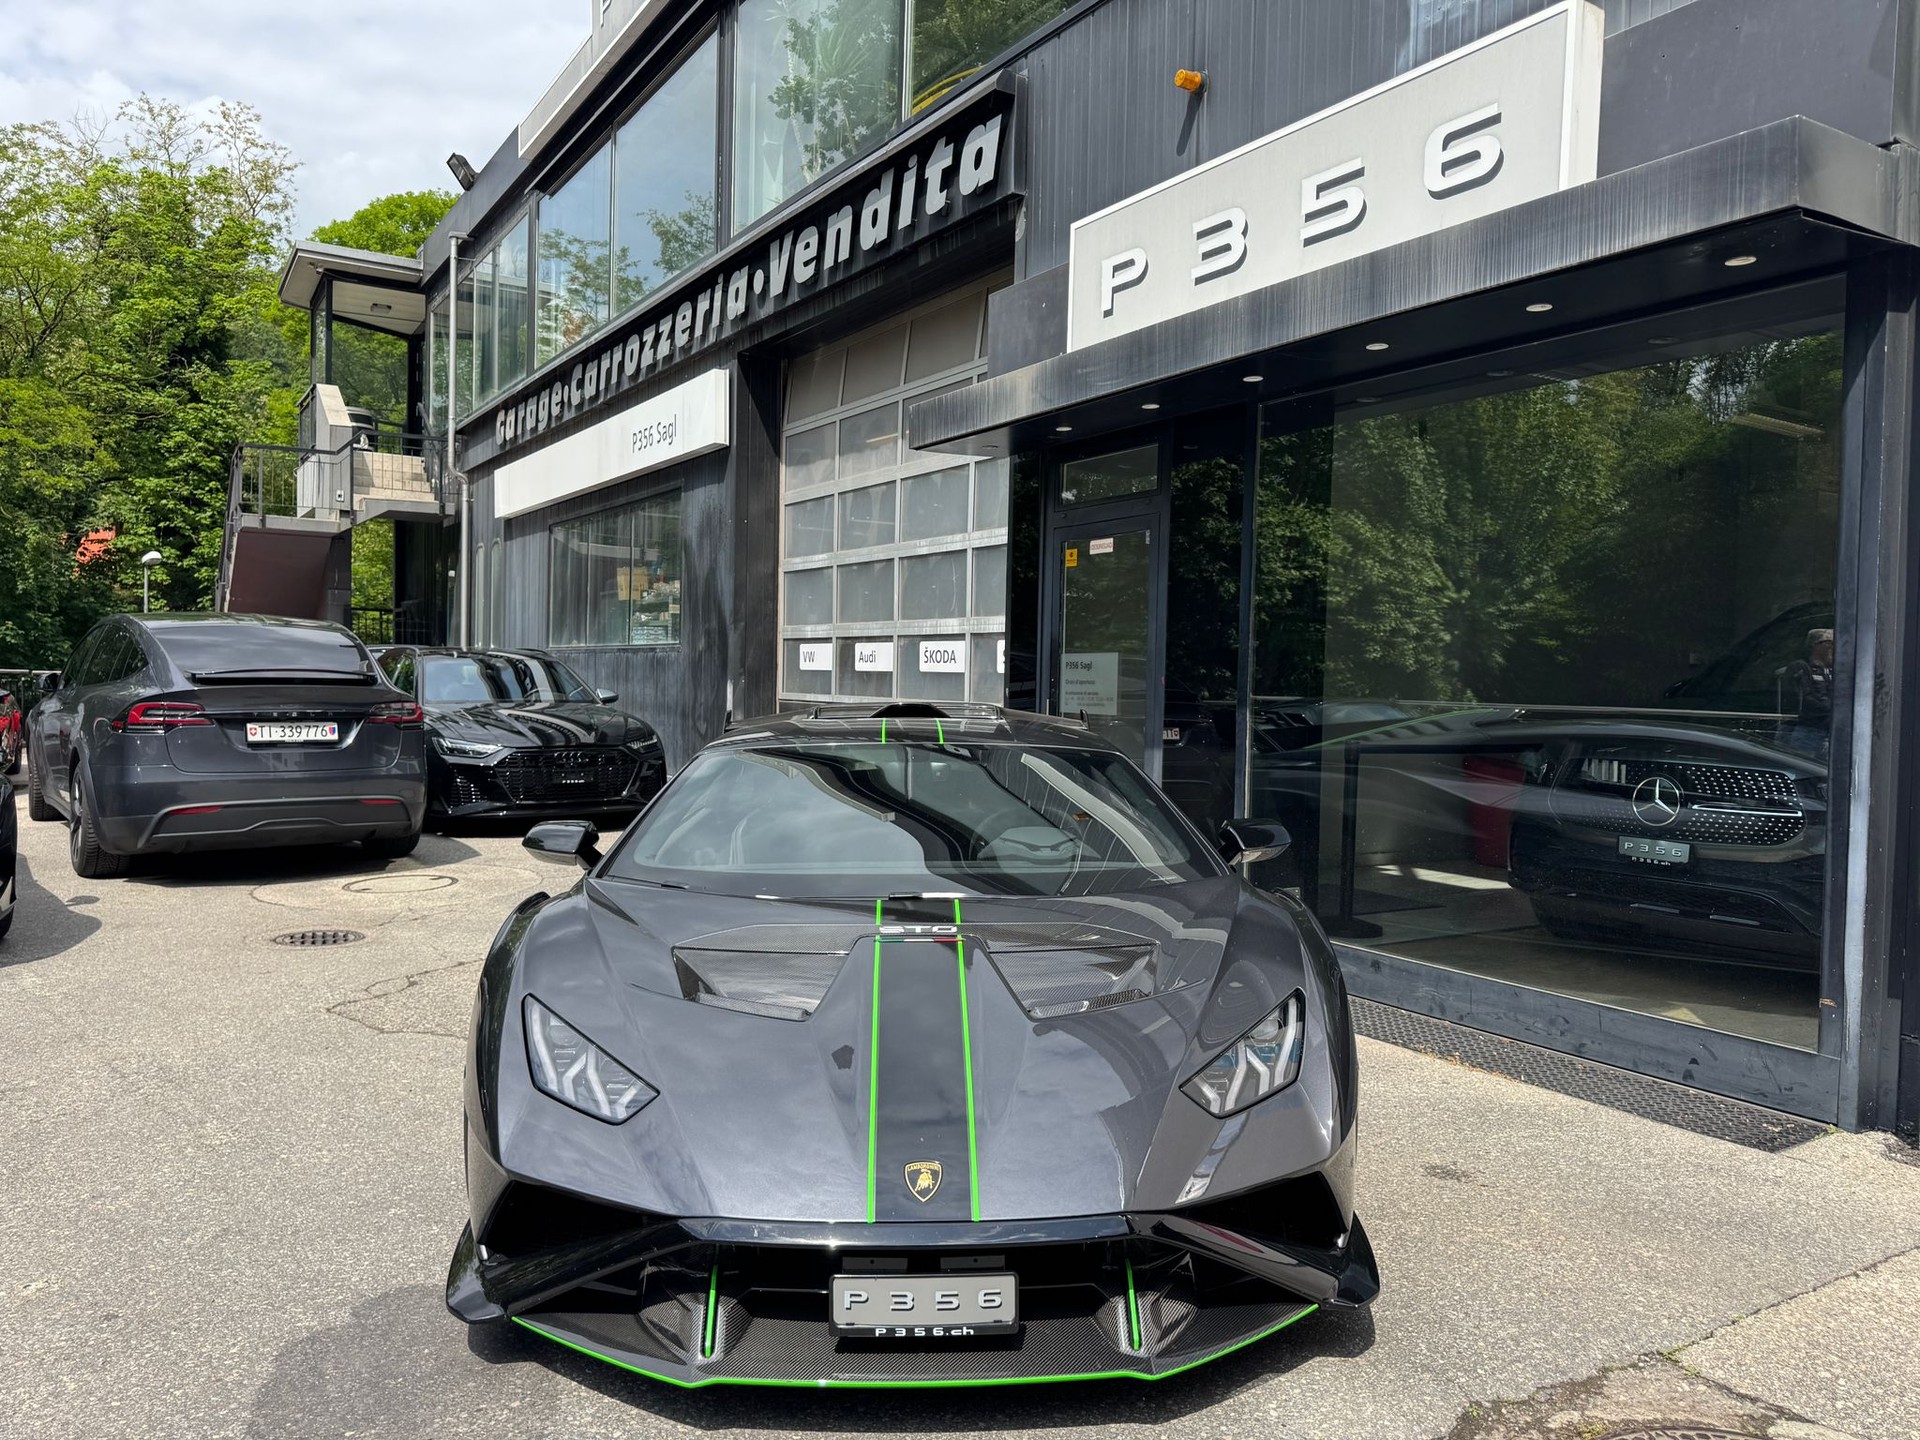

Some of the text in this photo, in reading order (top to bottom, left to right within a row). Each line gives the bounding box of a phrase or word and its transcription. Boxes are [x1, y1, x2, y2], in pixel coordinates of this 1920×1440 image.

[632, 414, 678, 454] P356 Sagl
[803, 650, 816, 663] VW
[858, 651, 876, 664] Audi
[923, 646, 957, 664] ŠKODA
[879, 925, 958, 934] STO
